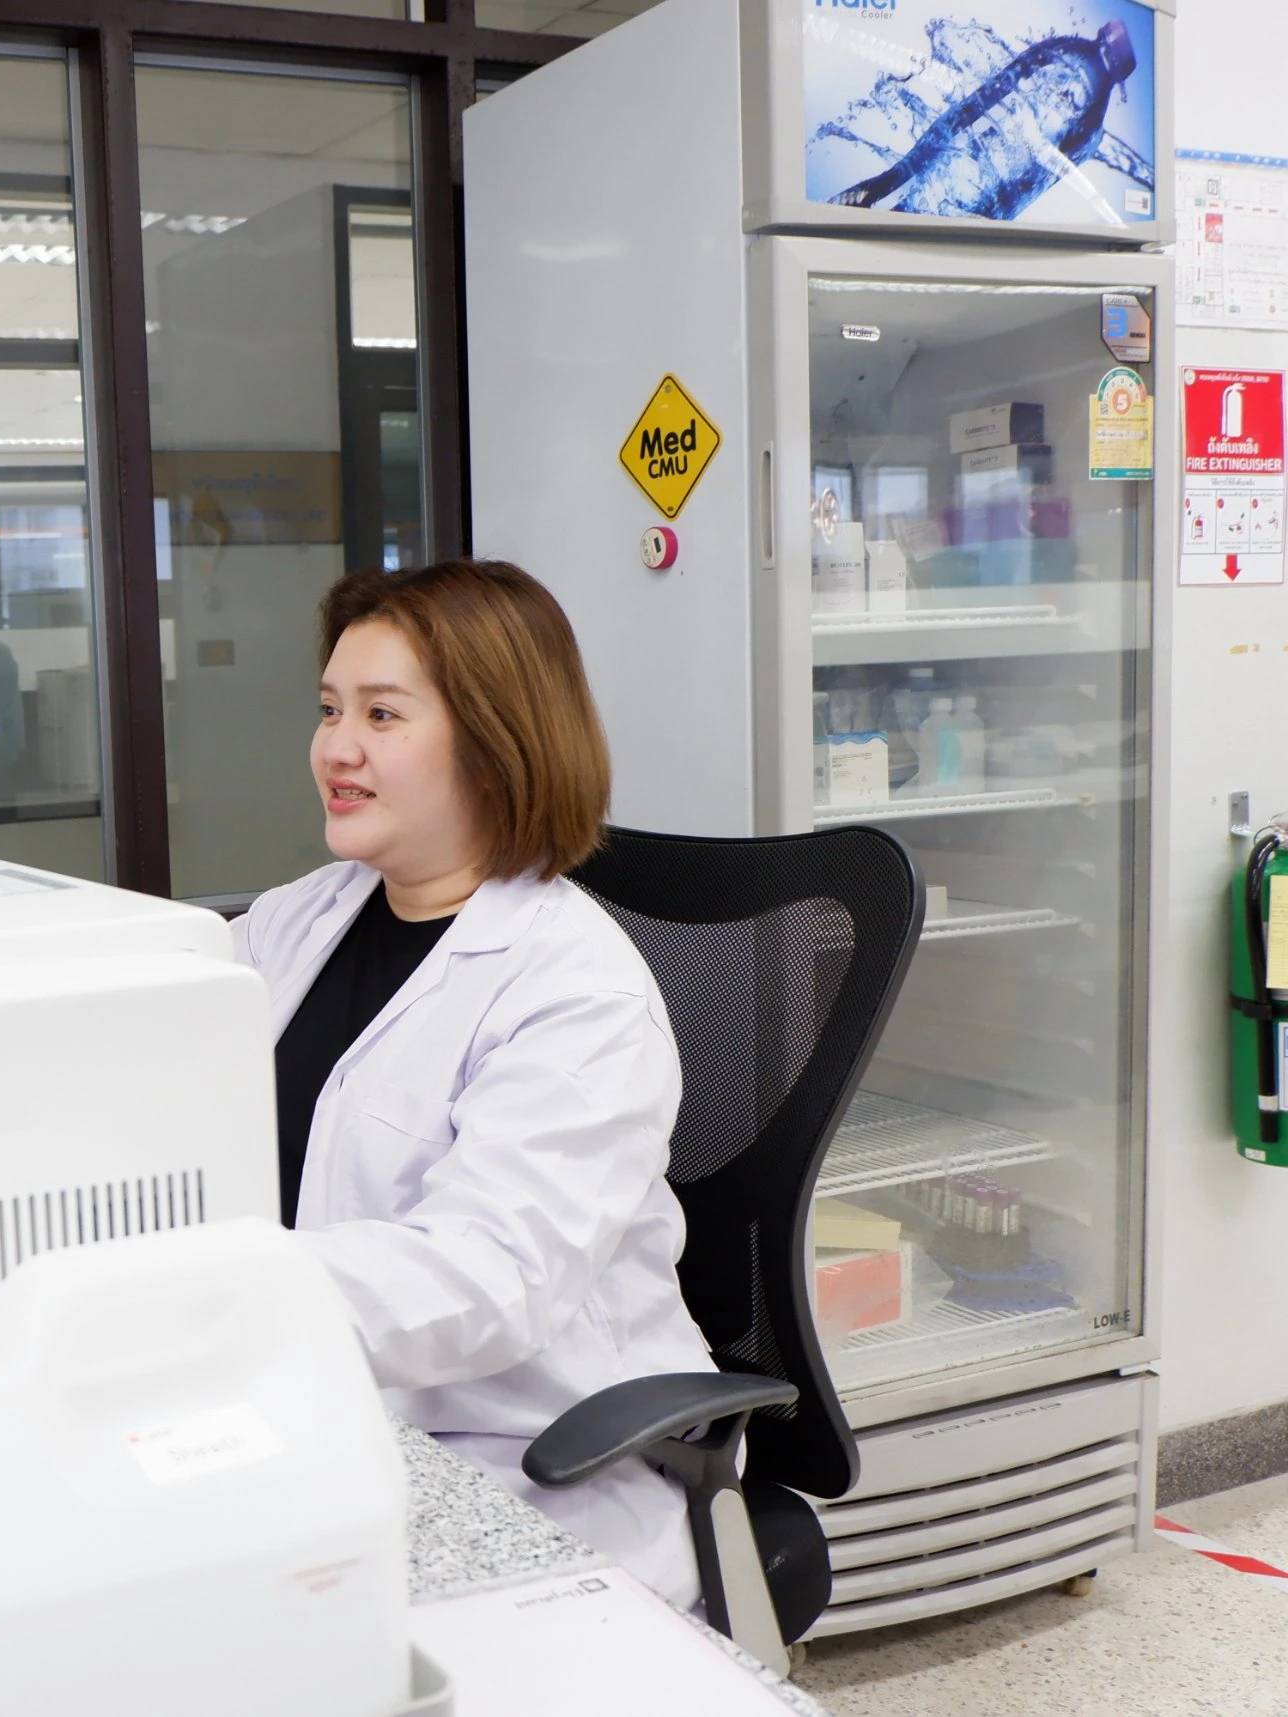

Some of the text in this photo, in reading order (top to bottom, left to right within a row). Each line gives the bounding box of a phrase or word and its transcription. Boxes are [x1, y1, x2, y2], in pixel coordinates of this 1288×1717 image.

[861, 10, 893, 19] Cooler
[1106, 306, 1128, 337] 3
[1116, 393, 1128, 411] 5
[640, 419, 696, 459] Med
[1208, 436, 1259, 454] ถังดับเพลิง
[648, 455, 688, 479] CMU
[1186, 457, 1282, 471] FIRE EXTINGUISHER
[1093, 1309, 1131, 1329] LOW-E
